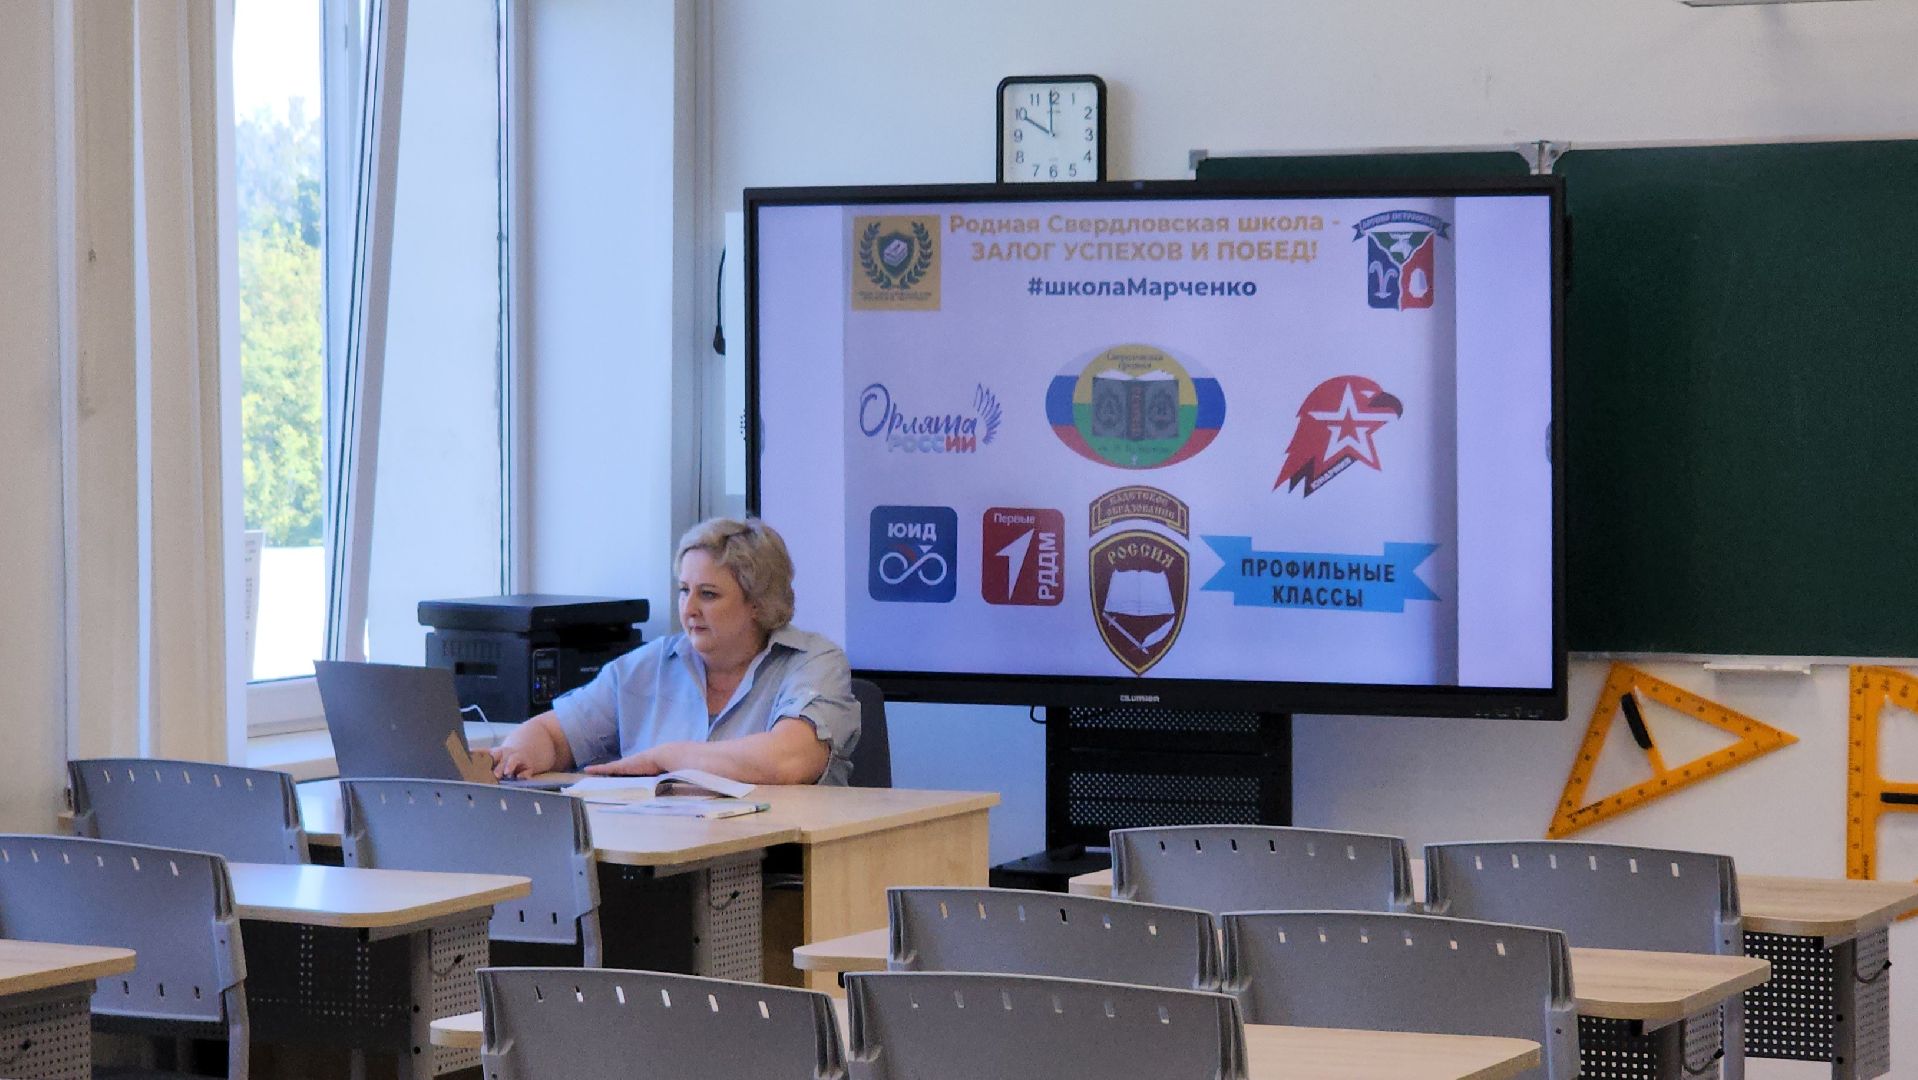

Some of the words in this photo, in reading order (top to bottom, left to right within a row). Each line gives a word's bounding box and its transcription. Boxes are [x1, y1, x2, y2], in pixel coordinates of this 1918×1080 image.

[1030, 93, 1040, 106] 11
[1049, 91, 1060, 105] 2
[1015, 107, 1028, 121] 10
[1084, 106, 1093, 120] 2
[1013, 129, 1023, 143] 9
[1084, 128, 1094, 142] 3
[1015, 151, 1025, 164] 8
[1083, 149, 1092, 163] 4
[1032, 164, 1040, 177] 7
[1049, 165, 1058, 178] 6
[1069, 163, 1077, 177] 5
[950, 214, 1040, 236] Родная
[1048, 214, 1230, 238] Свердловская
[1238, 214, 1324, 233] школа
[971, 240, 1056, 262] ЗАЛОГ
[1064, 240, 1183, 262] УСПЕХОВ
[1191, 240, 1209, 261] И
[1217, 239, 1318, 264] ПОБЕД!
[1027, 276, 1257, 301] #школаМарченко
[993, 512, 1036, 526] Первые
[887, 522, 937, 542] ЮИД
[1107, 543, 1175, 568] РОССИЯ
[1038, 532, 1060, 600] РДДМ
[1241, 558, 1396, 583] ПРОФИЛЬНЫЕ
[1273, 585, 1364, 608] КЛАССЫ
